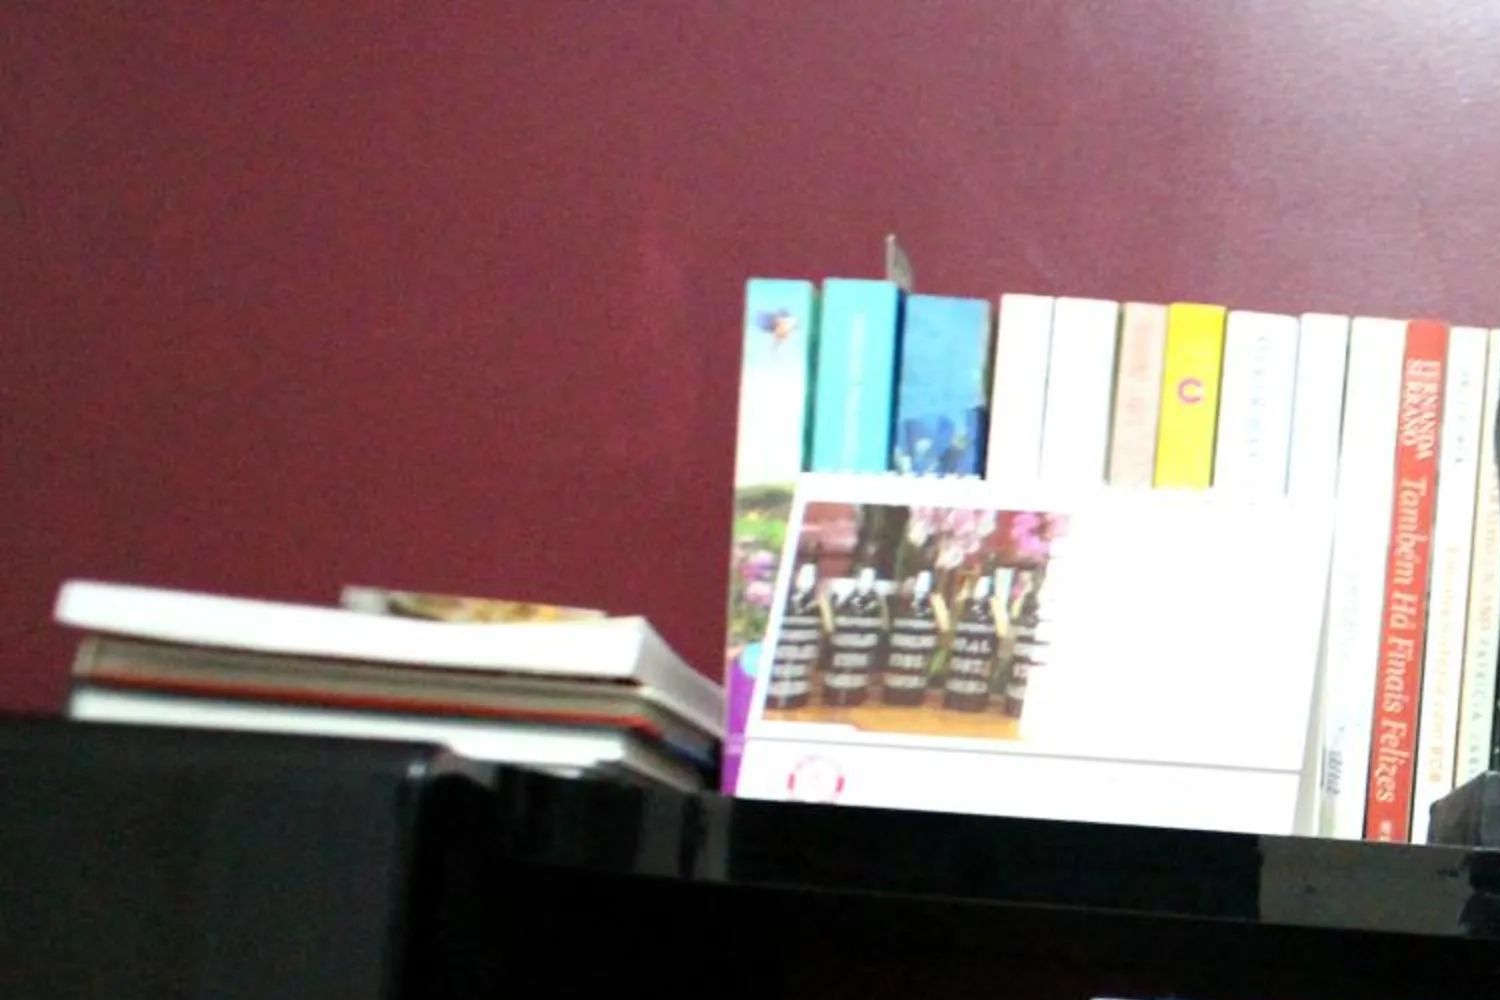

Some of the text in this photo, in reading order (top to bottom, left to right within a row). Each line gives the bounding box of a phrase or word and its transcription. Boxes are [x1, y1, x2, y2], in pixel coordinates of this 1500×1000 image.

[1399, 359, 1422, 445] SERRANO
[1415, 360, 1441, 459] FERNANDA
[1392, 476, 1427, 585] Também
[1388, 591, 1414, 630] Há
[1381, 636, 1412, 713] Finais
[1374, 718, 1407, 802] Felizes
